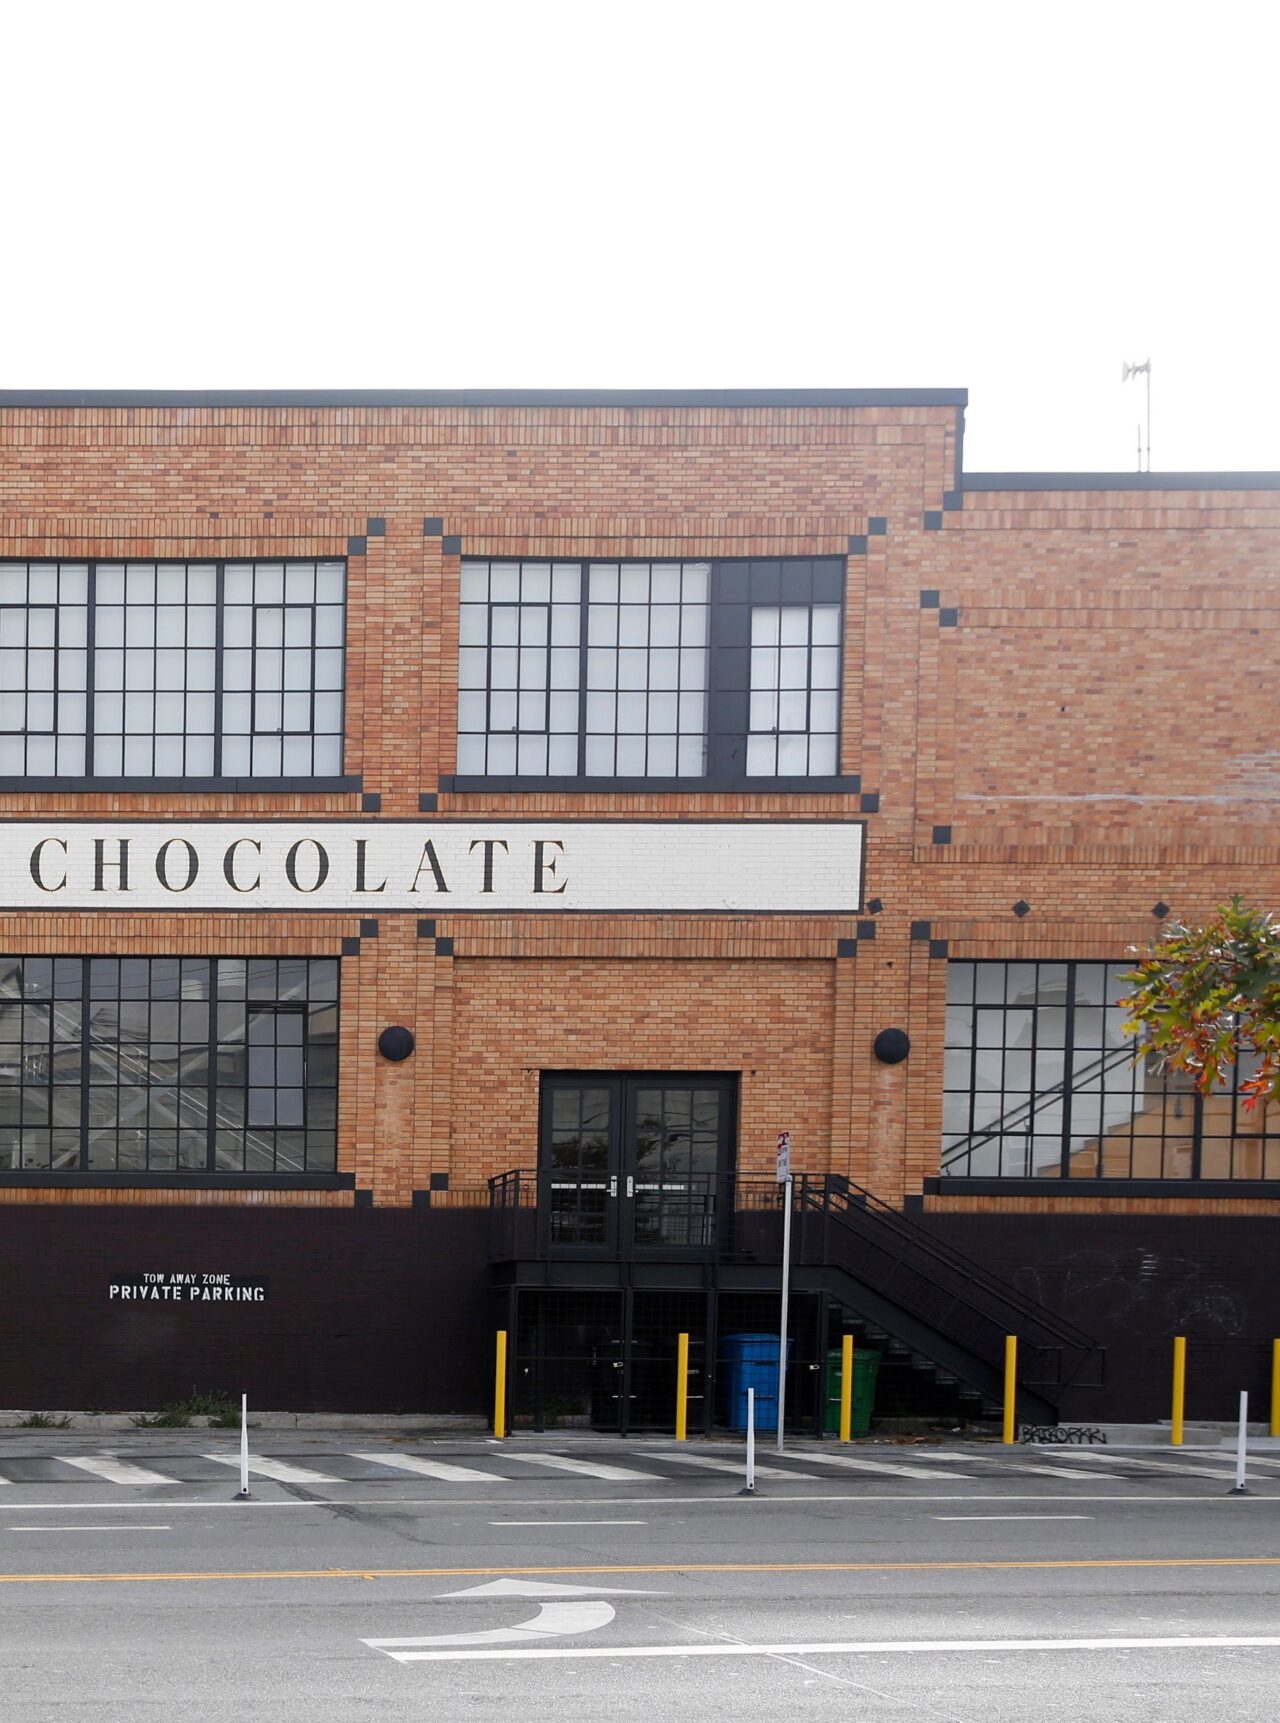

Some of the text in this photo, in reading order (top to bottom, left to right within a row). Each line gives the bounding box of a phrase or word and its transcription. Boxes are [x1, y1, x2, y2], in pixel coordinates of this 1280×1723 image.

[29, 839, 568, 893] CHOCOLATE
[143, 1273, 231, 1284] TOW AWAY ZONE
[109, 1285, 265, 1301] PRIVATE PARKING
